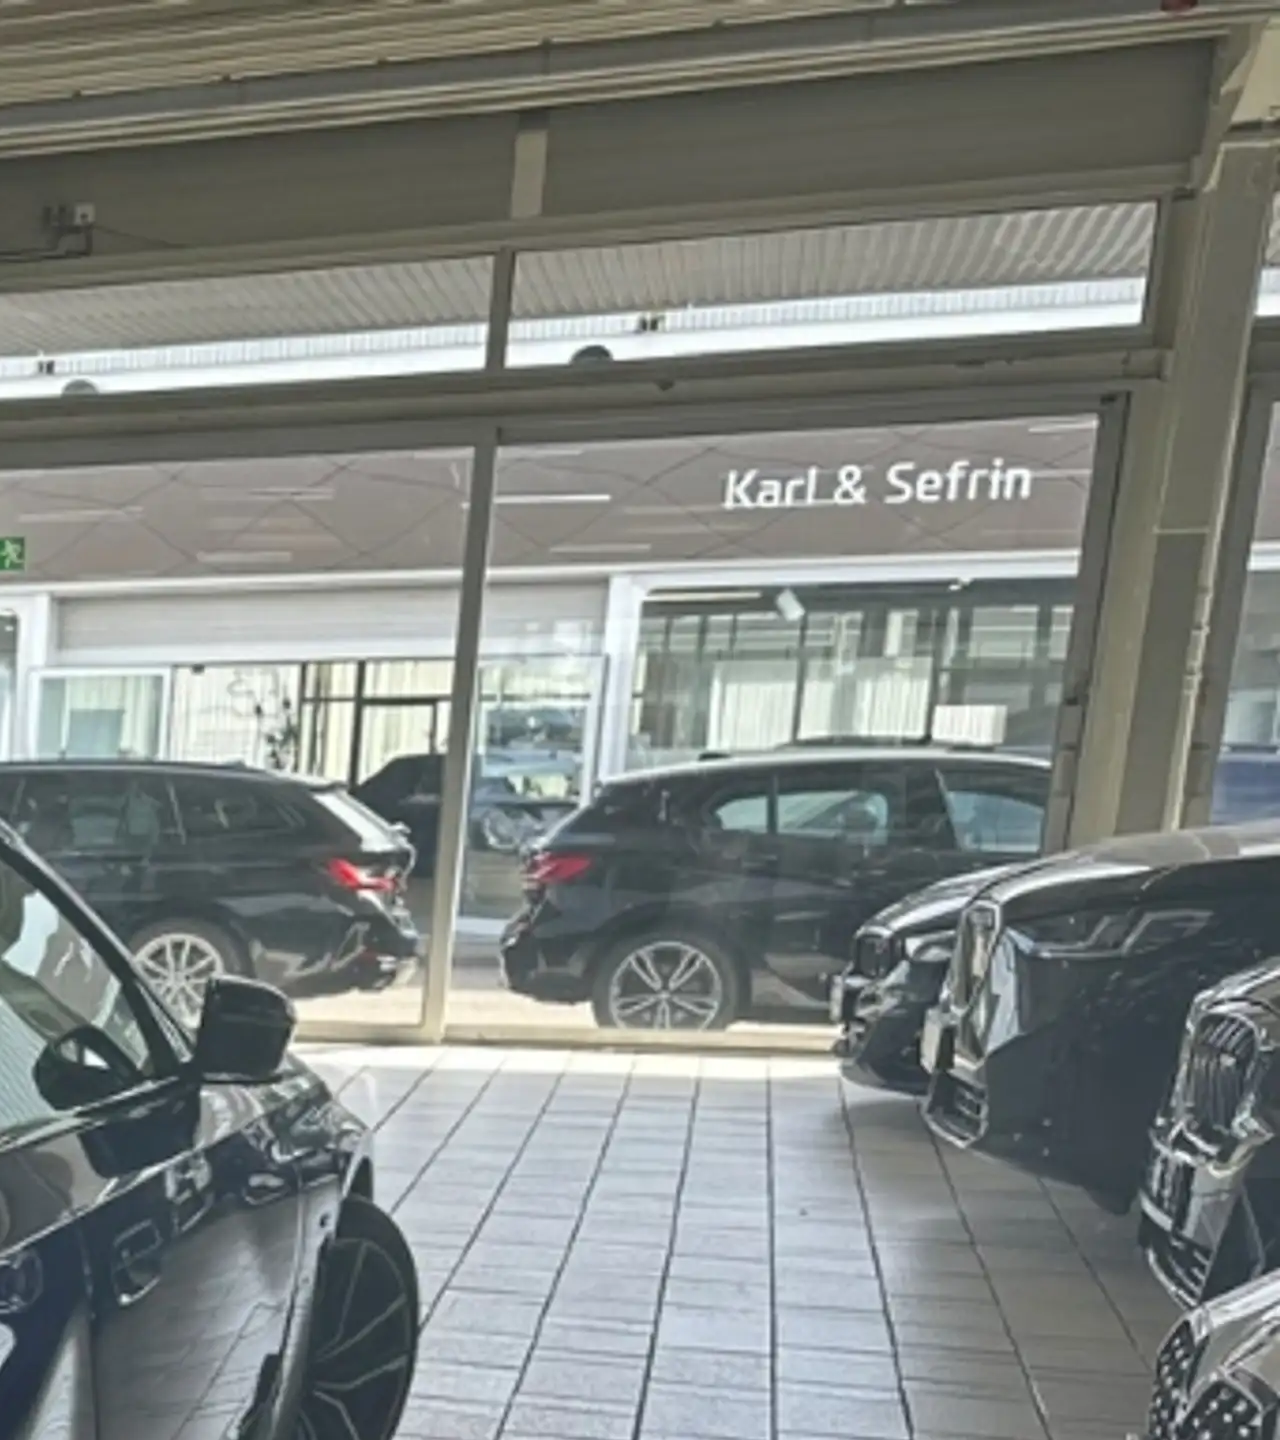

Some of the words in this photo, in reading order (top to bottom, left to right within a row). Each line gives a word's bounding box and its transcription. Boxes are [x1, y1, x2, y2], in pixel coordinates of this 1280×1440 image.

[724, 466, 817, 510] Karl
[833, 464, 866, 505] &
[884, 458, 1033, 504] Sefrin
